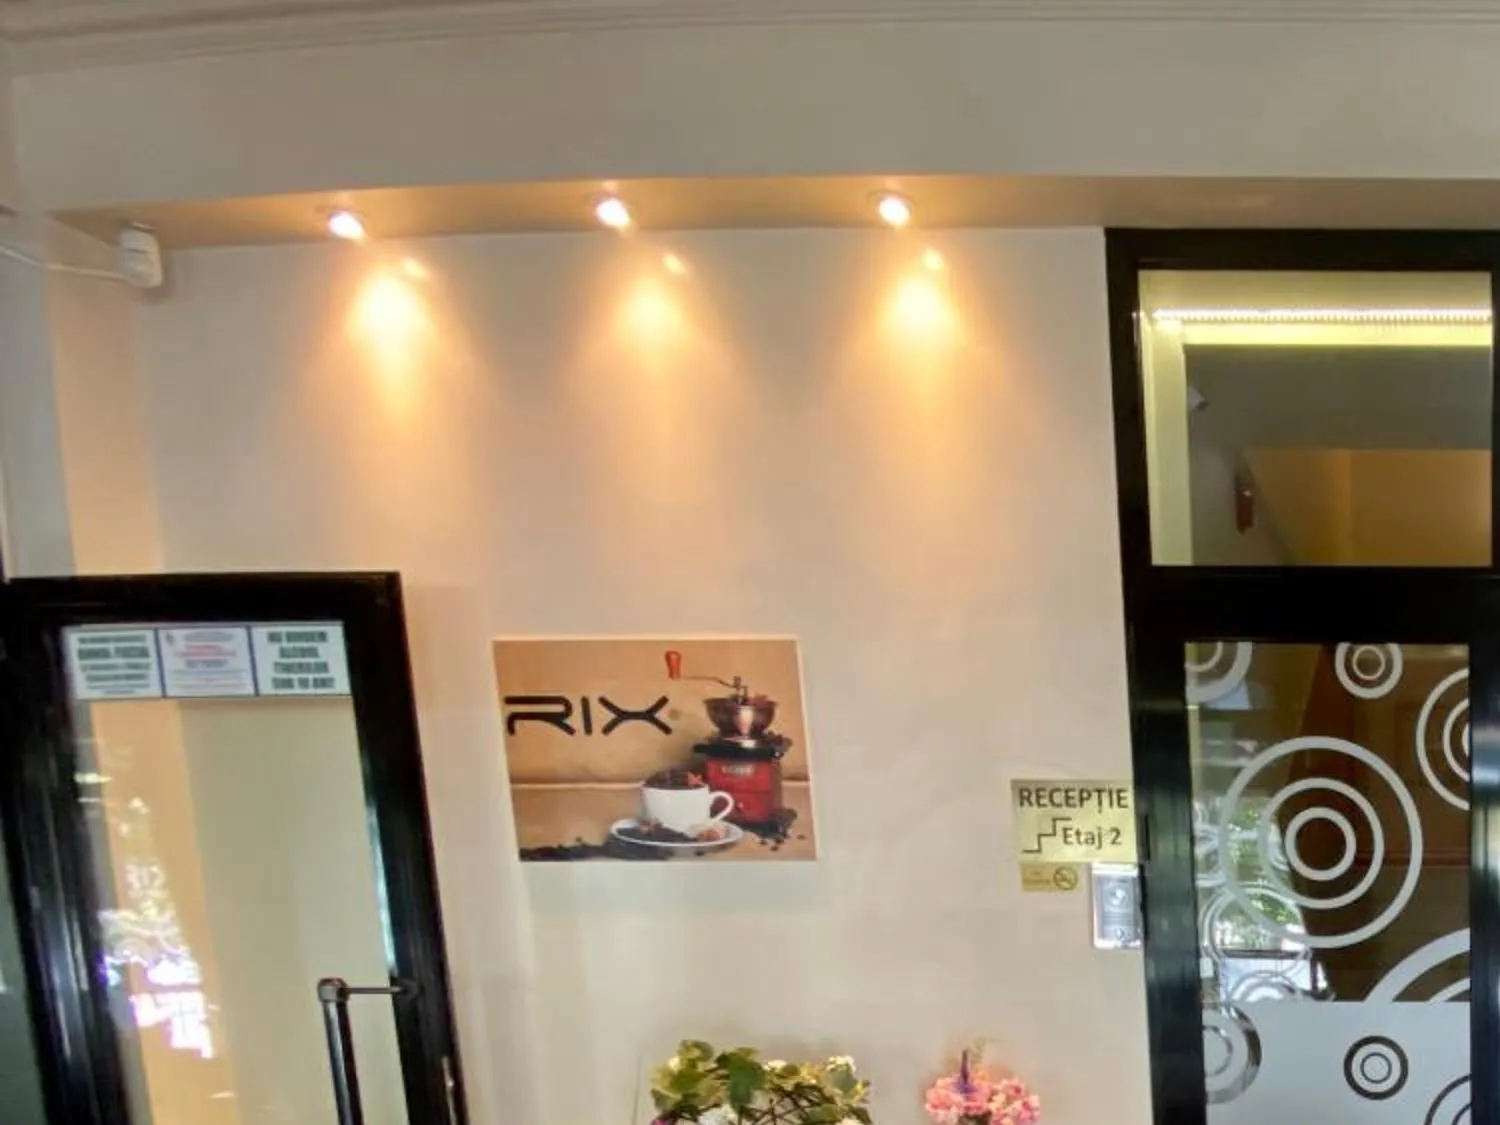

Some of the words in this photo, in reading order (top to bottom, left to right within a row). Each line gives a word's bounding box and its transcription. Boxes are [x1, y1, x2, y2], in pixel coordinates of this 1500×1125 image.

[504, 695, 673, 736] RIX
[1062, 826, 1103, 850] Etaj
[1109, 827, 1122, 845] 2
